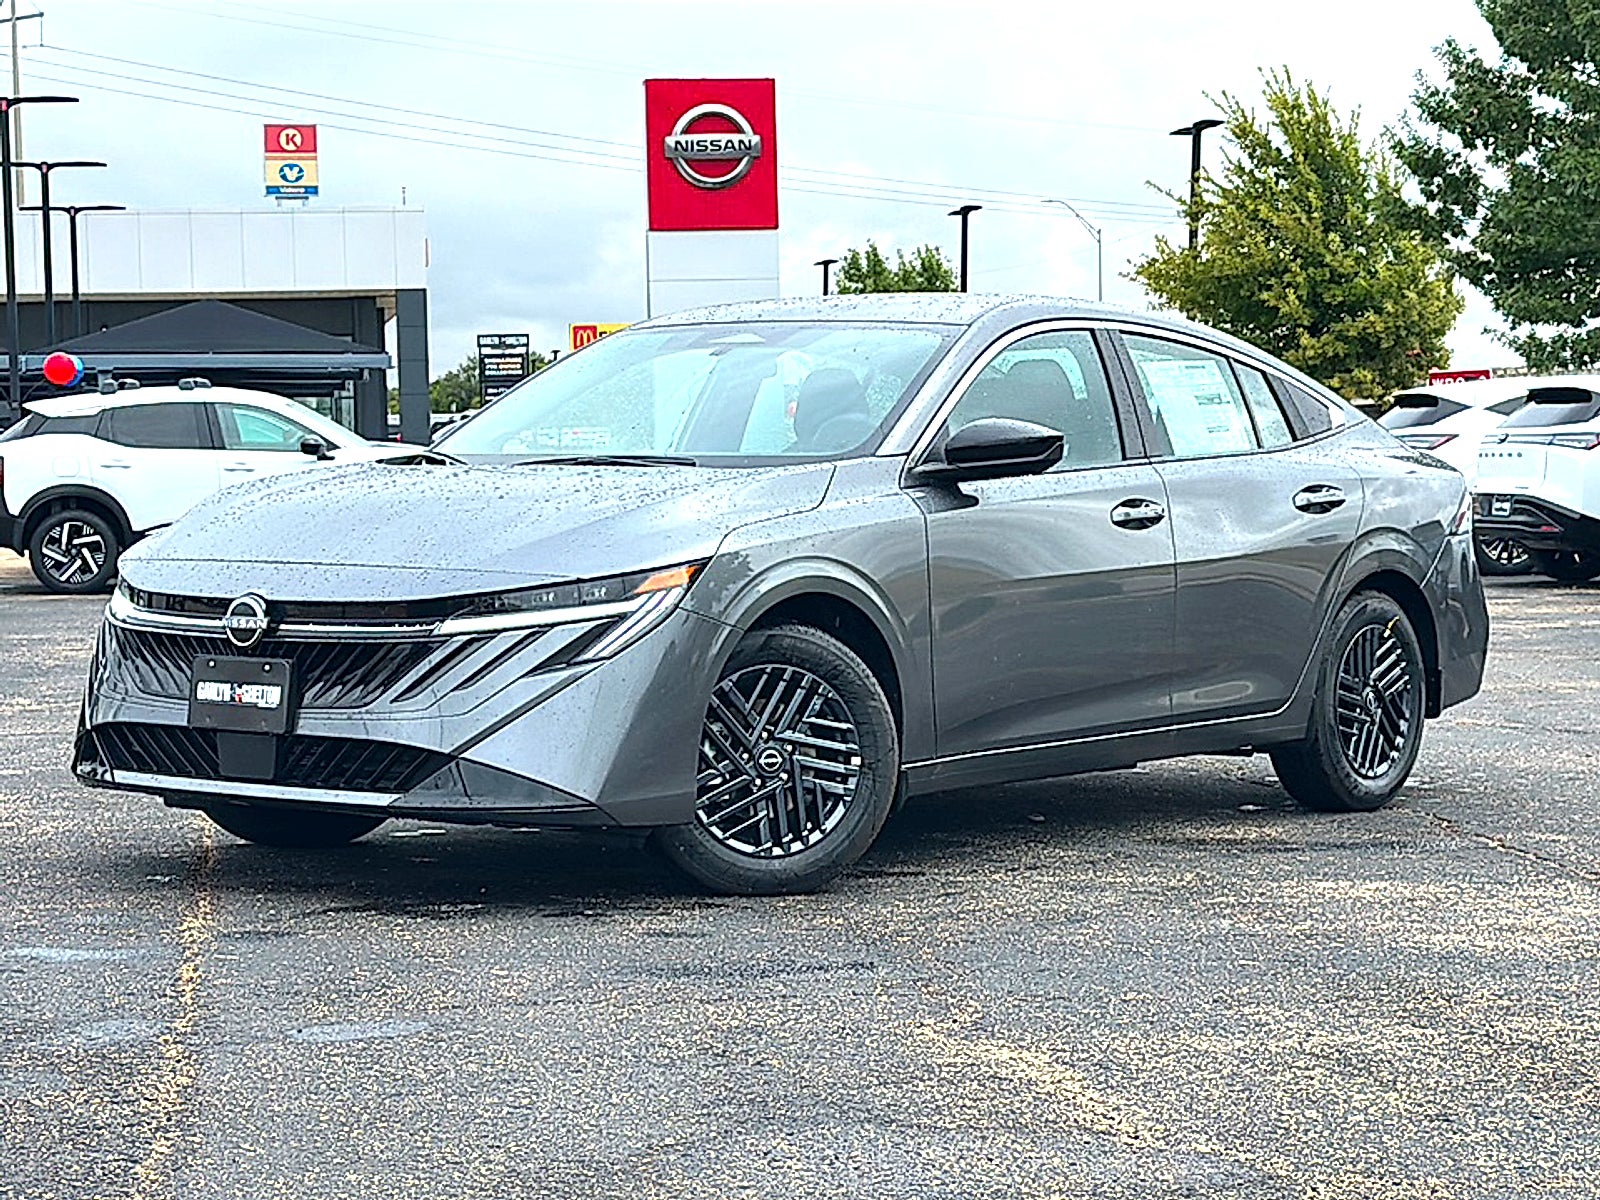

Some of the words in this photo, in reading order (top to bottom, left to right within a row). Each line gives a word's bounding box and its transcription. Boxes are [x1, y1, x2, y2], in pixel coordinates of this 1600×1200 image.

[285, 133, 300, 149] K
[674, 139, 752, 153] NISSAN
[224, 617, 268, 629] NISSAN
